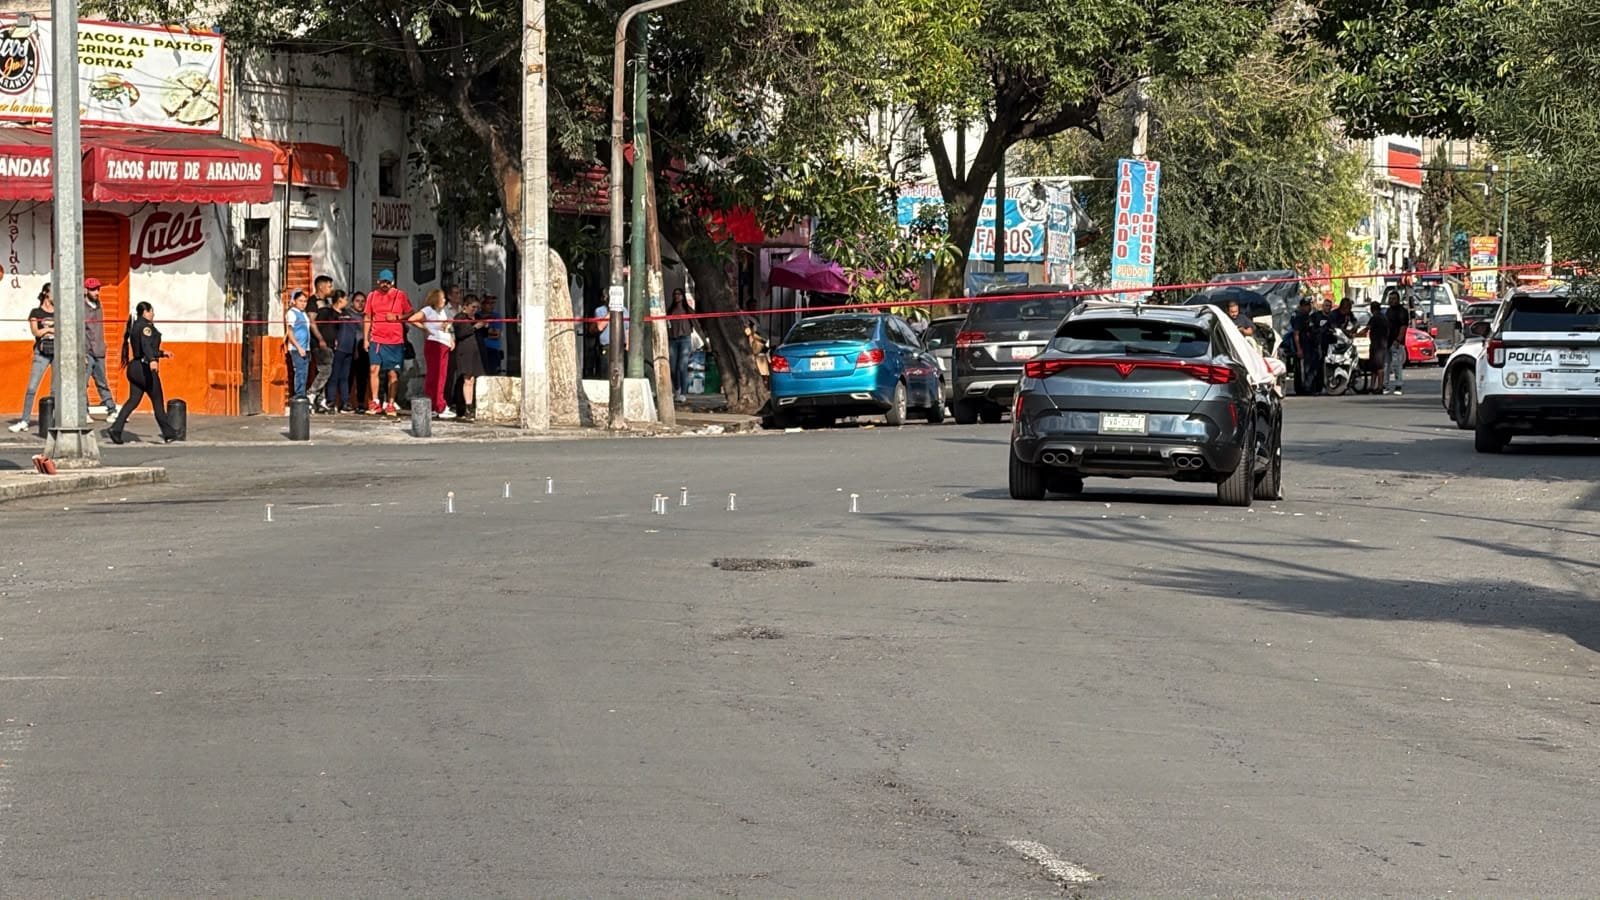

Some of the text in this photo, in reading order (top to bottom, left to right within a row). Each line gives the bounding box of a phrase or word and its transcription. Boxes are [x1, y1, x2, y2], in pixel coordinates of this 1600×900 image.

[77, 31, 213, 53] TACOS AL PASTOR
[77, 43, 144, 58] GRINGAS
[77, 56, 132, 69] TORTAS
[107, 161, 262, 181] TACOS JUVE DE ARANDAS
[981, 207, 993, 217] EN
[1117, 160, 1158, 264] LAVADO DE VESTIDURAS
[1508, 350, 1552, 361] POLICÍA
